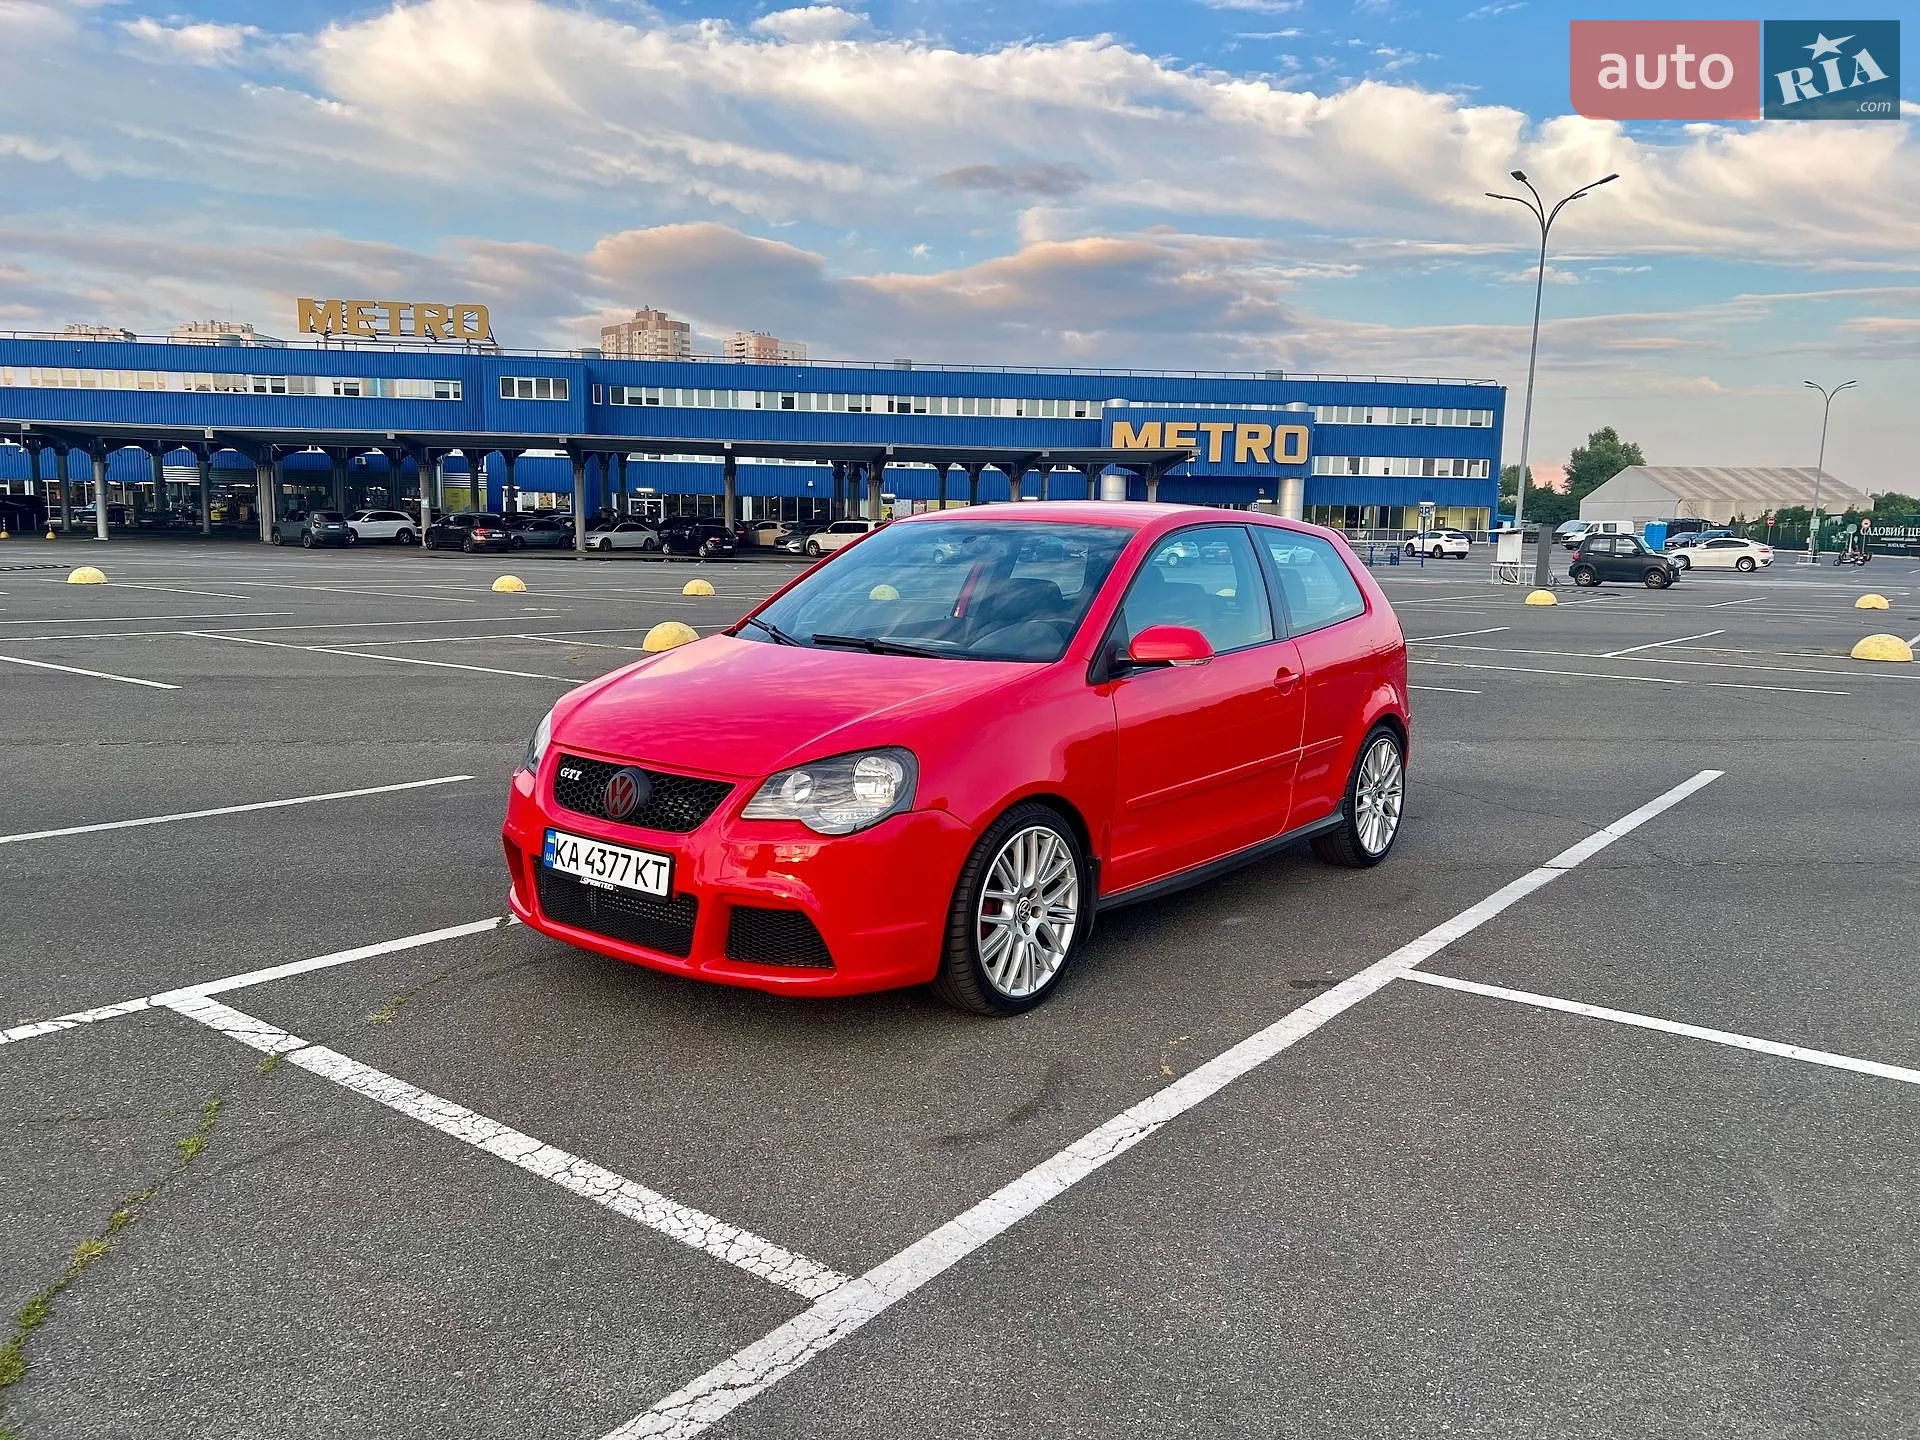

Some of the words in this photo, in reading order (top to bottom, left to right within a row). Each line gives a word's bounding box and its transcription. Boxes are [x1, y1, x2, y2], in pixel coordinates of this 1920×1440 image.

[297, 297, 490, 340] METRO
[1112, 421, 1310, 464] METRO
[1860, 525, 1905, 537] САДОВИЙ
[560, 767, 582, 781] GTI
[545, 852, 554, 863] UA
[554, 838, 579, 871] KA
[584, 846, 632, 882] 4377
[634, 856, 667, 891] KT
